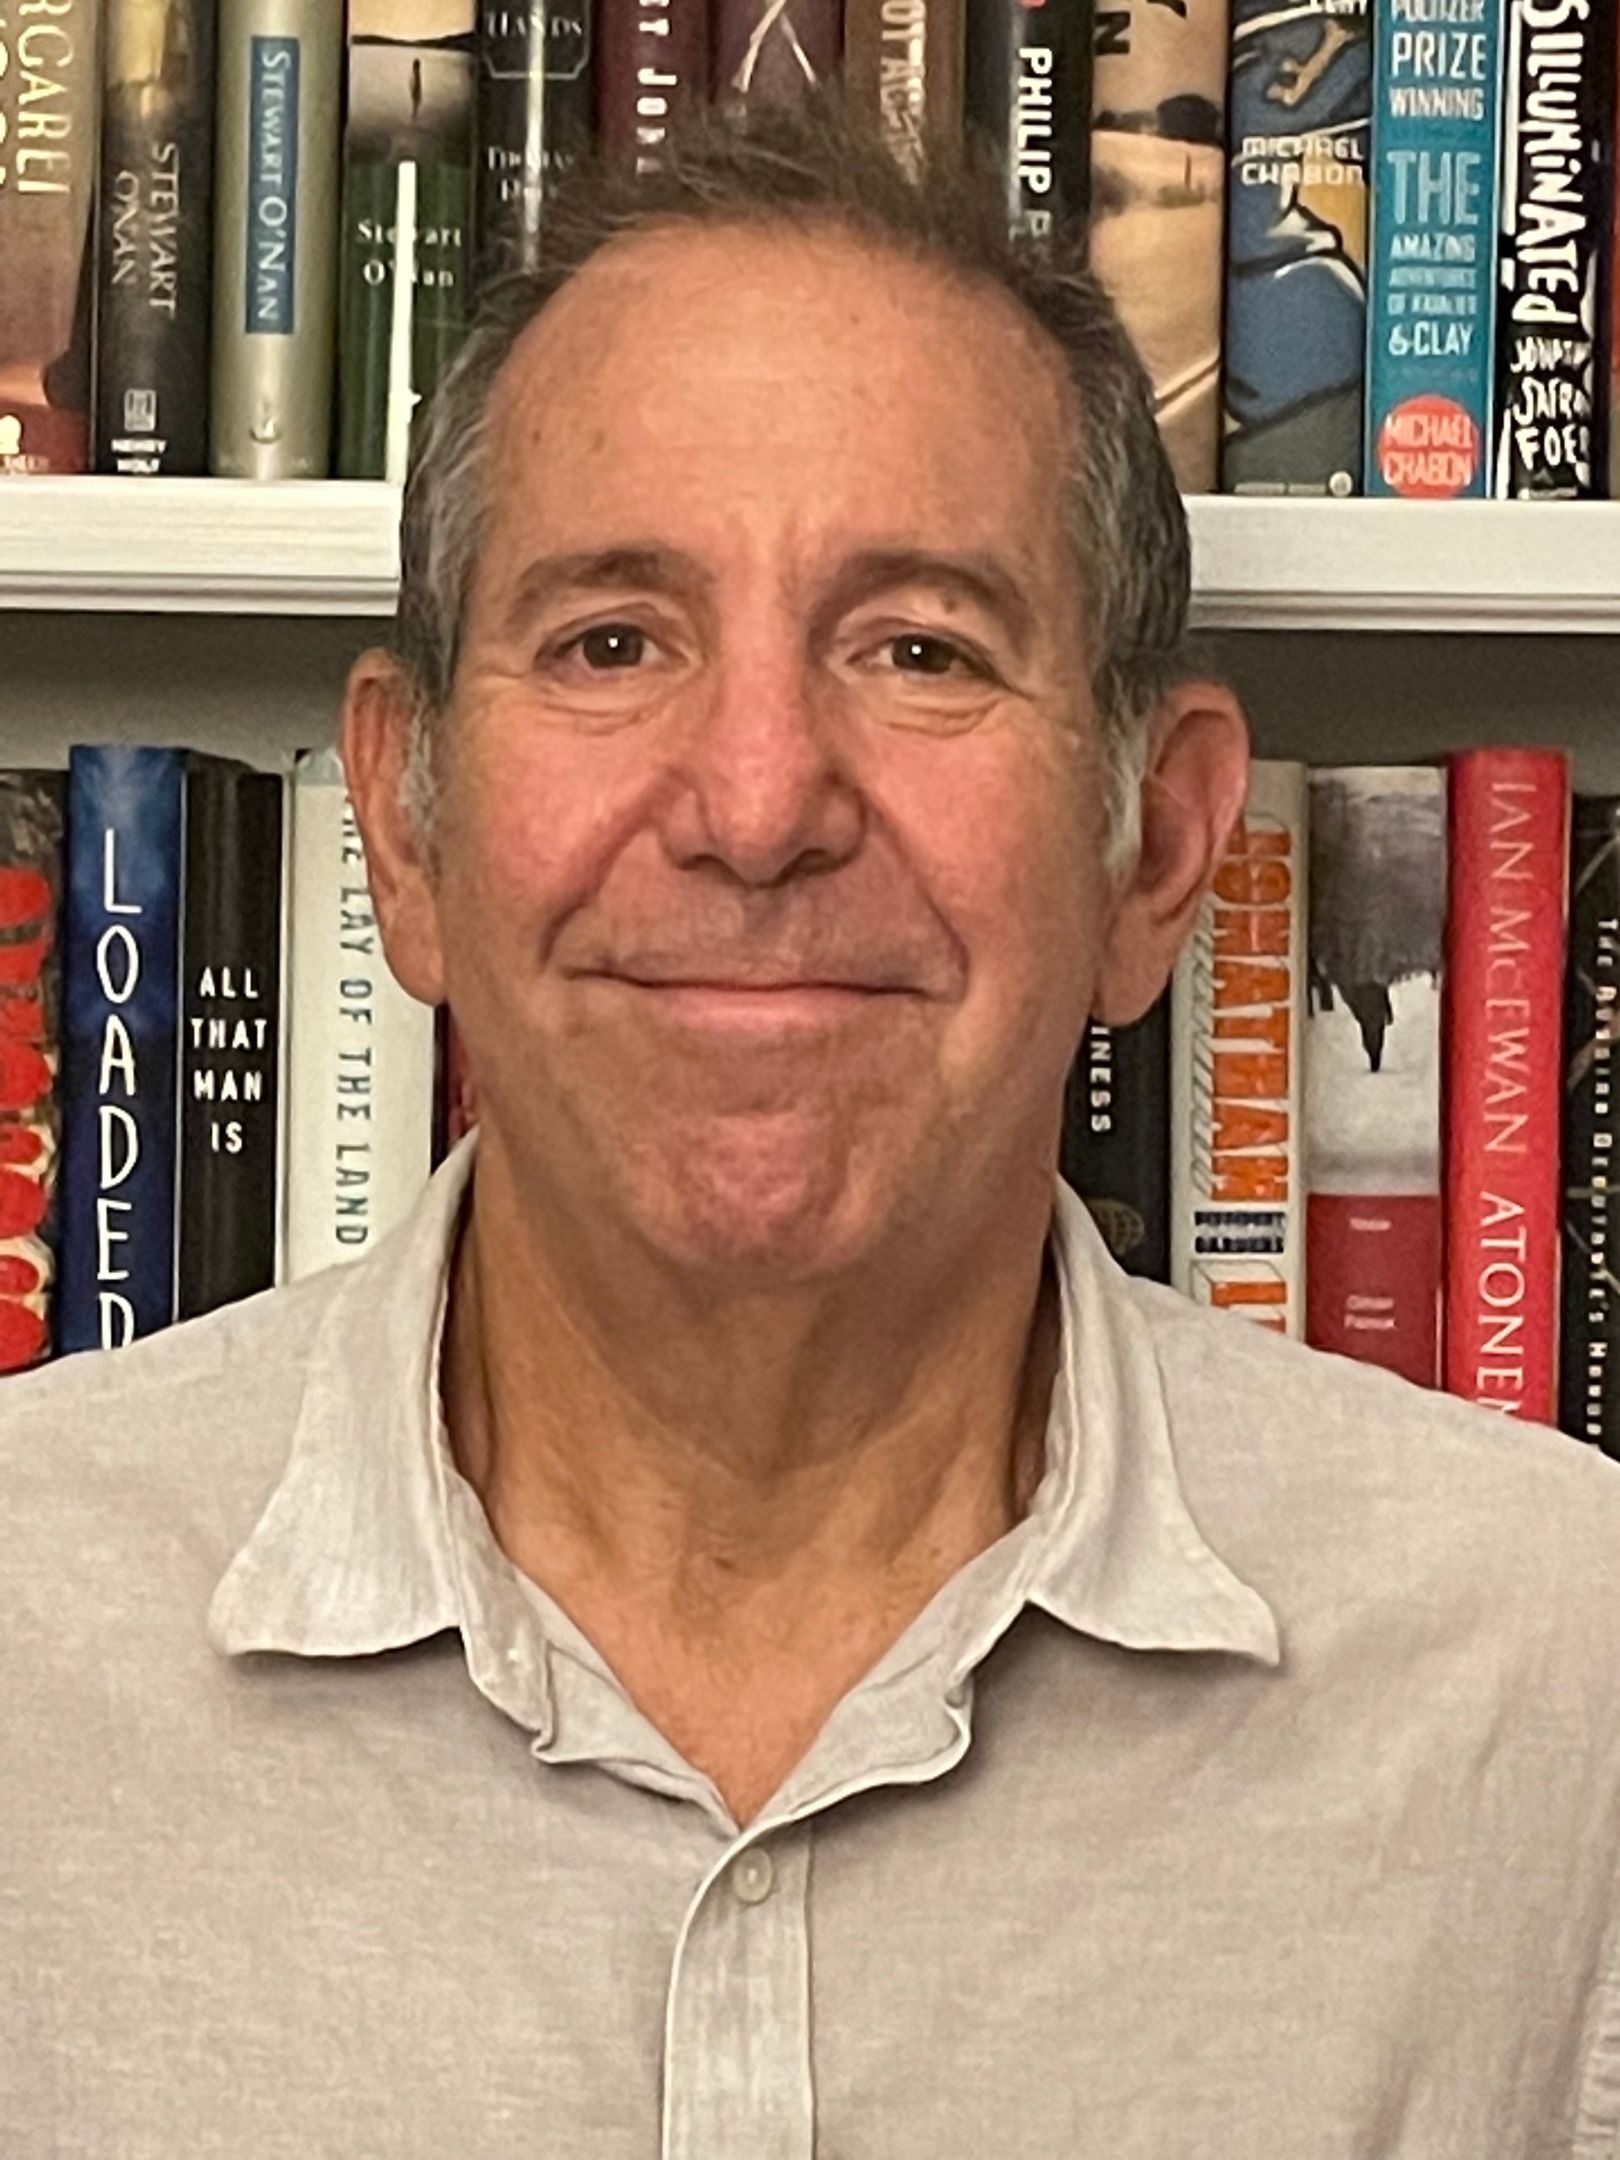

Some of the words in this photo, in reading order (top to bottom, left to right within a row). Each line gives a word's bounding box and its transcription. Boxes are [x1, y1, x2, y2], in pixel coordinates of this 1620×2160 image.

[1391, 31, 1487, 80] PRIZE
[1017, 47, 1053, 194] PHILIP
[1389, 86, 1485, 121] WINNING
[1387, 151, 1481, 226] THE
[149, 142, 180, 320] STEWART
[1384, 411, 1474, 449] MICHAEL
[1383, 451, 1473, 486] CHABON
[1489, 783, 1536, 880] IAN
[340, 886, 376, 955] LAY
[200, 966, 259, 998] ALL
[340, 979, 373, 1025] OF
[191, 1018, 267, 1049] THAT
[97, 828, 142, 1350] LOADED
[193, 1070, 262, 1101] MAN
[337, 1047, 371, 1121] THE
[211, 1122, 243, 1153] IS
[335, 1143, 371, 1245] LAND
